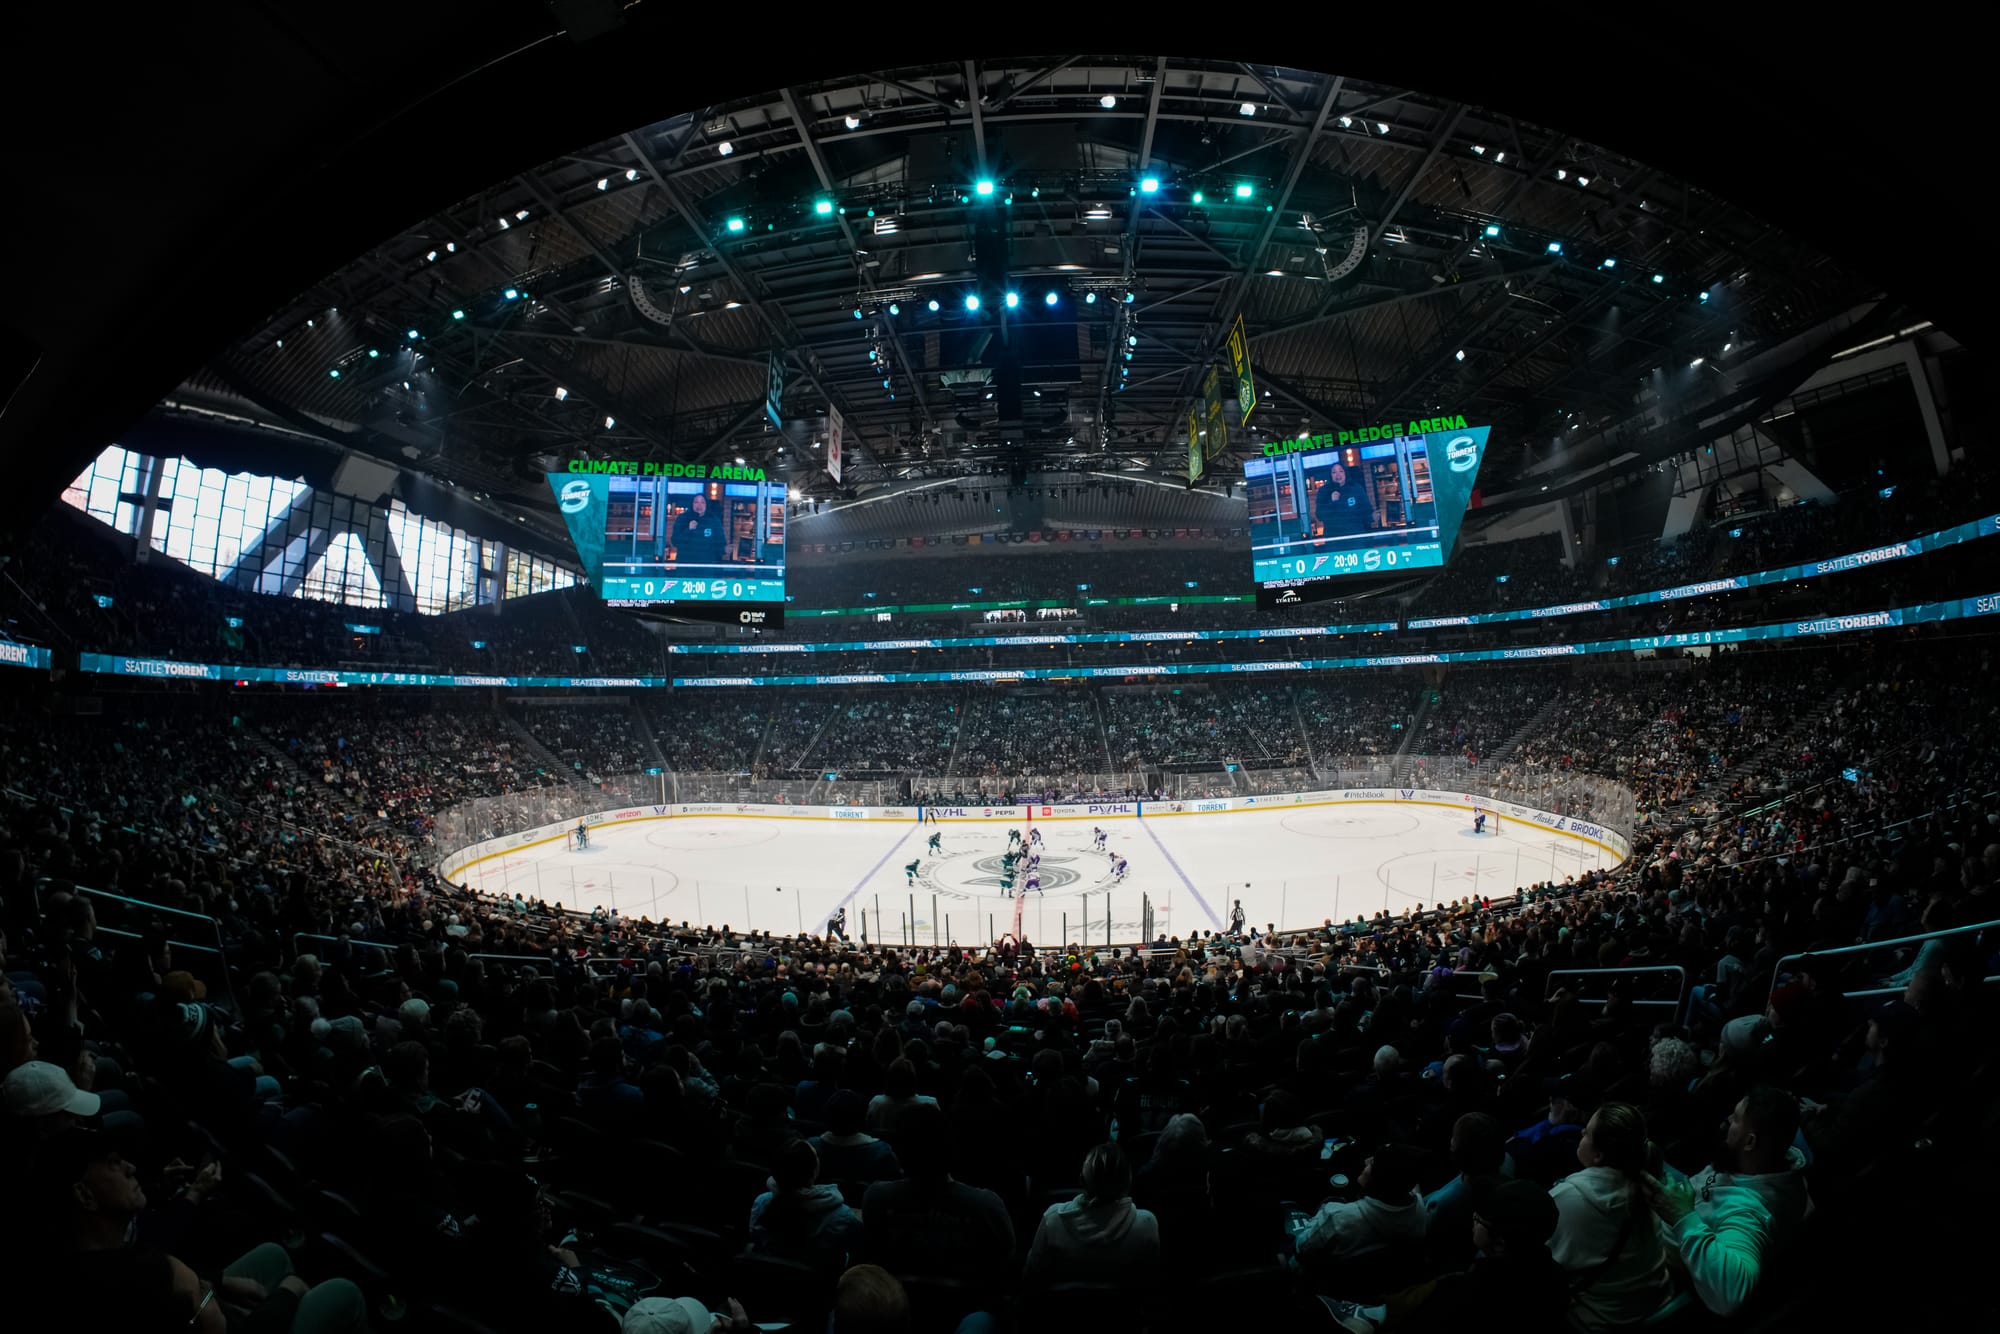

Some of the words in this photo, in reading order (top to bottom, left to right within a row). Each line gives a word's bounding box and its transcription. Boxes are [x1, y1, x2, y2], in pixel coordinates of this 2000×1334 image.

[1263, 432, 1334, 457] CLIMATE
[1338, 423, 1404, 443] PLEDGE
[1408, 415, 1468, 435] ARENA
[1448, 445, 1477, 460] TORRENT
[568, 460, 638, 475] CLIMATE
[643, 463, 706, 478] PLEDGE
[710, 466, 766, 481] ARENA
[1334, 554, 1358, 568] 20:00
[1387, 551, 1397, 565] 0
[1817, 557, 1855, 573] SEATTLE
[1856, 544, 1907, 565] TORRENT
[1296, 560, 1305, 574] 0
[644, 581, 654, 595] 0
[682, 581, 705, 593] 20:00
[733, 582, 742, 597] 0
[1660, 587, 1692, 599] SEATTLE
[1693, 579, 1735, 593] TORRENT
[1531, 606, 1562, 617] SEATTLE
[1563, 602, 1598, 613] TORRENT
[1432, 617, 1468, 627] TORRENT
[1798, 622, 1836, 634] SEATTLE
[1838, 613, 1889, 629] TORRENT
[1130, 633, 1162, 641] SEATTLE
[1162, 632, 1198, 640] TORRENT
[1260, 629, 1292, 637] SEATTLE
[1292, 627, 1325, 636] TORRENT
[895, 640, 931, 648] TORRENT
[995, 637, 1029, 645] SEATTLE
[1029, 635, 1065, 643] TORRENT
[769, 644, 804, 652] TORRENT
[1504, 649, 1536, 658] SEATTLE
[1537, 645, 1574, 656] TORRENT
[1367, 656, 1399, 666] SEATTLE
[1400, 654, 1438, 664] TORRENT
[125, 660, 163, 674] SEATTLE
[164, 663, 208, 676] TORRENT
[1093, 667, 1128, 676] SEATTLE
[1128, 666, 1166, 675] TORRENT
[1231, 663, 1264, 671] SEATTLE
[1264, 661, 1301, 670] TORRENT
[287, 671, 326, 681] SEATTLE
[816, 676, 848, 684] SEATTLE
[848, 675, 884, 683] TORRENT
[951, 672, 984, 680] SEATTLE
[984, 670, 1024, 679] TORRENT
[472, 677, 507, 686] TORRENT
[571, 679, 602, 687] SEATTLE
[603, 678, 640, 687] TORRENT
[684, 679, 716, 687] SEATTLE
[716, 678, 752, 686] TORRENT
[1089, 804, 1132, 815] PWHL
[1198, 803, 1227, 811] TORRENT
[615, 810, 641, 818] verizon
[835, 811, 863, 819] TORRENT
[1532, 812, 1555, 825] Alaska
[1570, 821, 1603, 838] BROOKS
